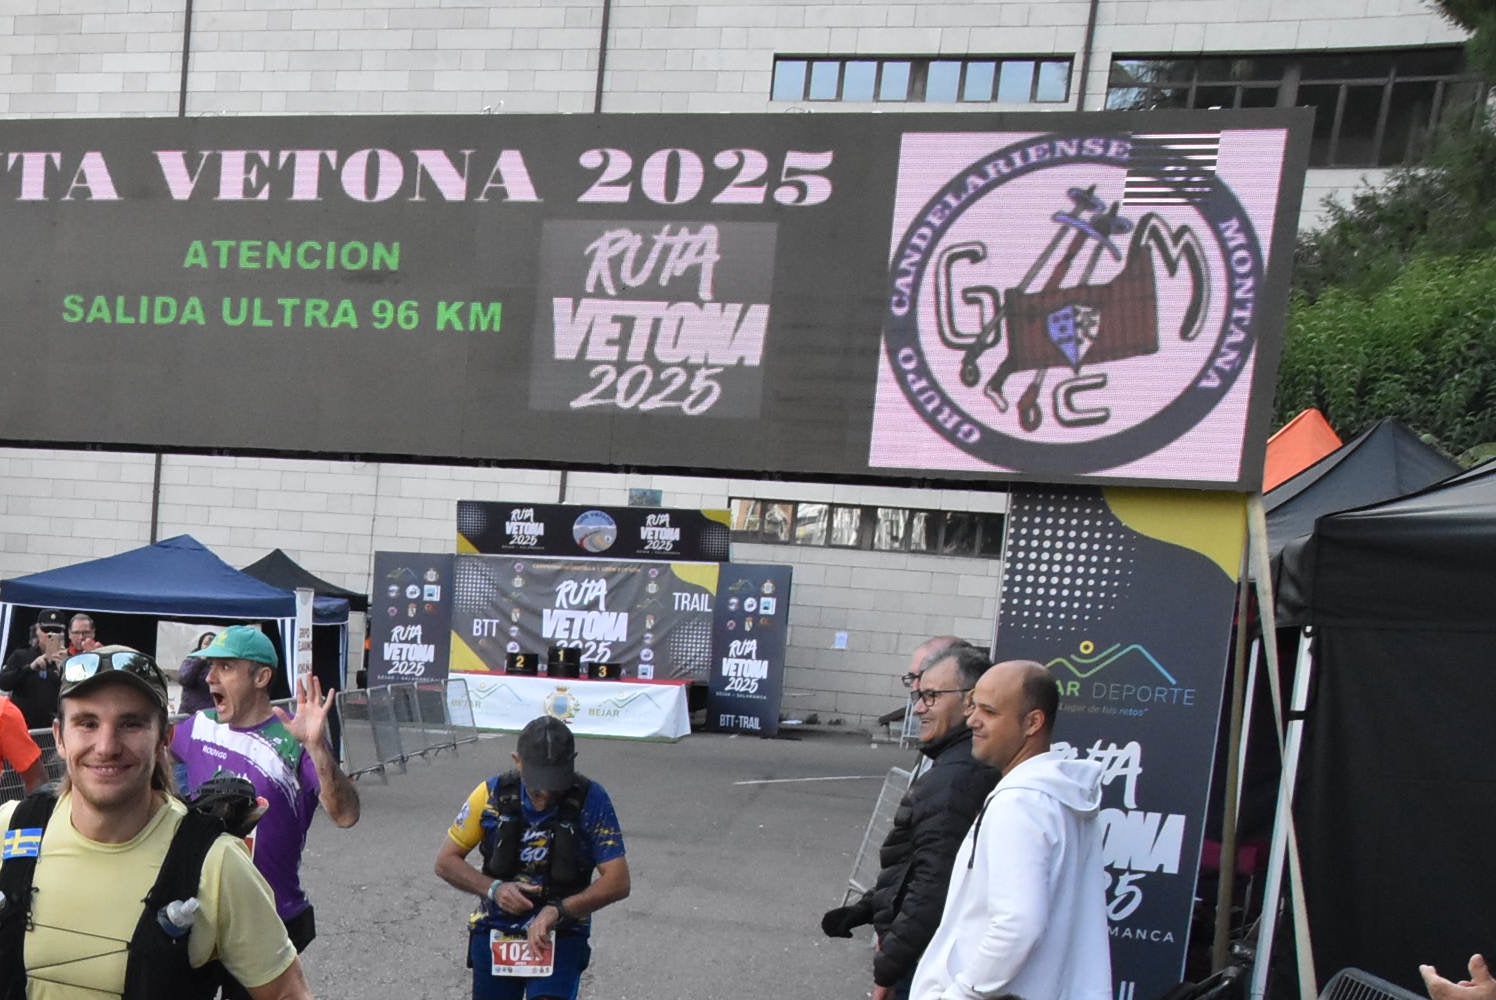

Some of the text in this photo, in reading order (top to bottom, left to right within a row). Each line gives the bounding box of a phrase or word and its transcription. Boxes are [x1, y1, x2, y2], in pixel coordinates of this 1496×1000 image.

[152, 148, 544, 203] VETONA
[576, 147, 834, 206] 2025
[890, 138, 1132, 317] CANDELARIENSE
[183, 240, 401, 271] ATENCION
[584, 223, 721, 301] RUTA
[62, 293, 502, 332] SALIDA ULTRA 96 KM
[552, 297, 771, 367] VETONA
[569, 363, 725, 416] 2025
[898, 347, 982, 443] GRUPO
[510, 508, 535, 523] RUTA
[645, 513, 670, 528] RUTA
[505, 521, 545, 537] VETONA
[640, 526, 681, 542] VETONA
[509, 534, 538, 546] 2025
[644, 539, 673, 551] 2025
[555, 578, 608, 612] RUTA
[672, 592, 713, 612] TRAIL
[391, 624, 423, 644] RUTA
[472, 618, 500, 637] BTT
[542, 608, 629, 642] VETONA
[383, 642, 436, 663] VETONA
[557, 650, 565, 662] 1
[728, 639, 758, 660] RUTA
[387, 661, 425, 676] 2025
[515, 656, 525, 668] 2
[598, 666, 607, 678] 3
[721, 657, 769, 680] VETONA
[725, 676, 759, 693] 2025
[1091, 682, 1197, 707] DEPORTE
[498, 942, 542, 962] 102
